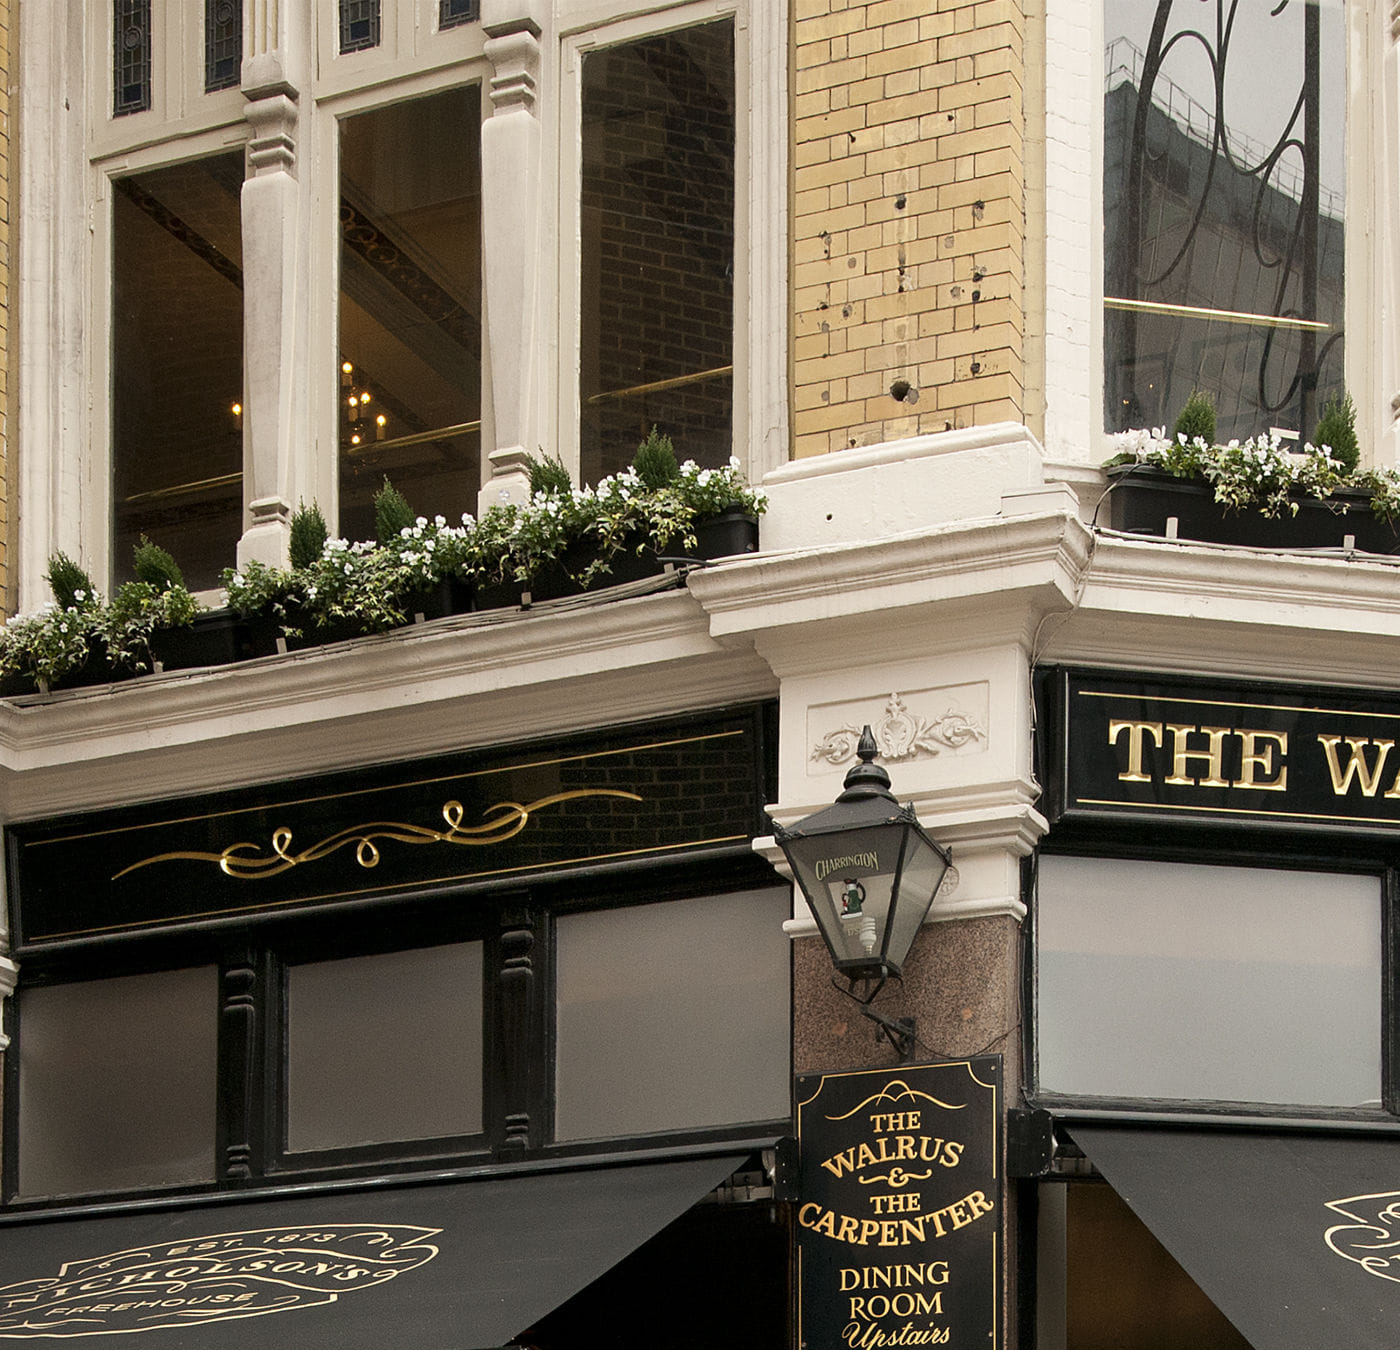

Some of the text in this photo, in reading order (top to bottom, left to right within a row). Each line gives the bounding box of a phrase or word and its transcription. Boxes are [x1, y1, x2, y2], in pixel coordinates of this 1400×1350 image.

[1108, 718, 1288, 792] THE
[815, 851, 879, 881] CHARRINGTON
[870, 1111, 921, 1133] THE
[820, 1135, 965, 1179] WALRUS
[798, 1190, 995, 1247] CARPENTER
[870, 1192, 921, 1215] THE
[167, 1232, 338, 1256] EST. 1873
[2, 1258, 371, 1309] NICHOLSON'S
[839, 1261, 950, 1291] DINING
[44, 1291, 258, 1316] FREEHOUSE
[850, 1291, 944, 1321] ROOM
